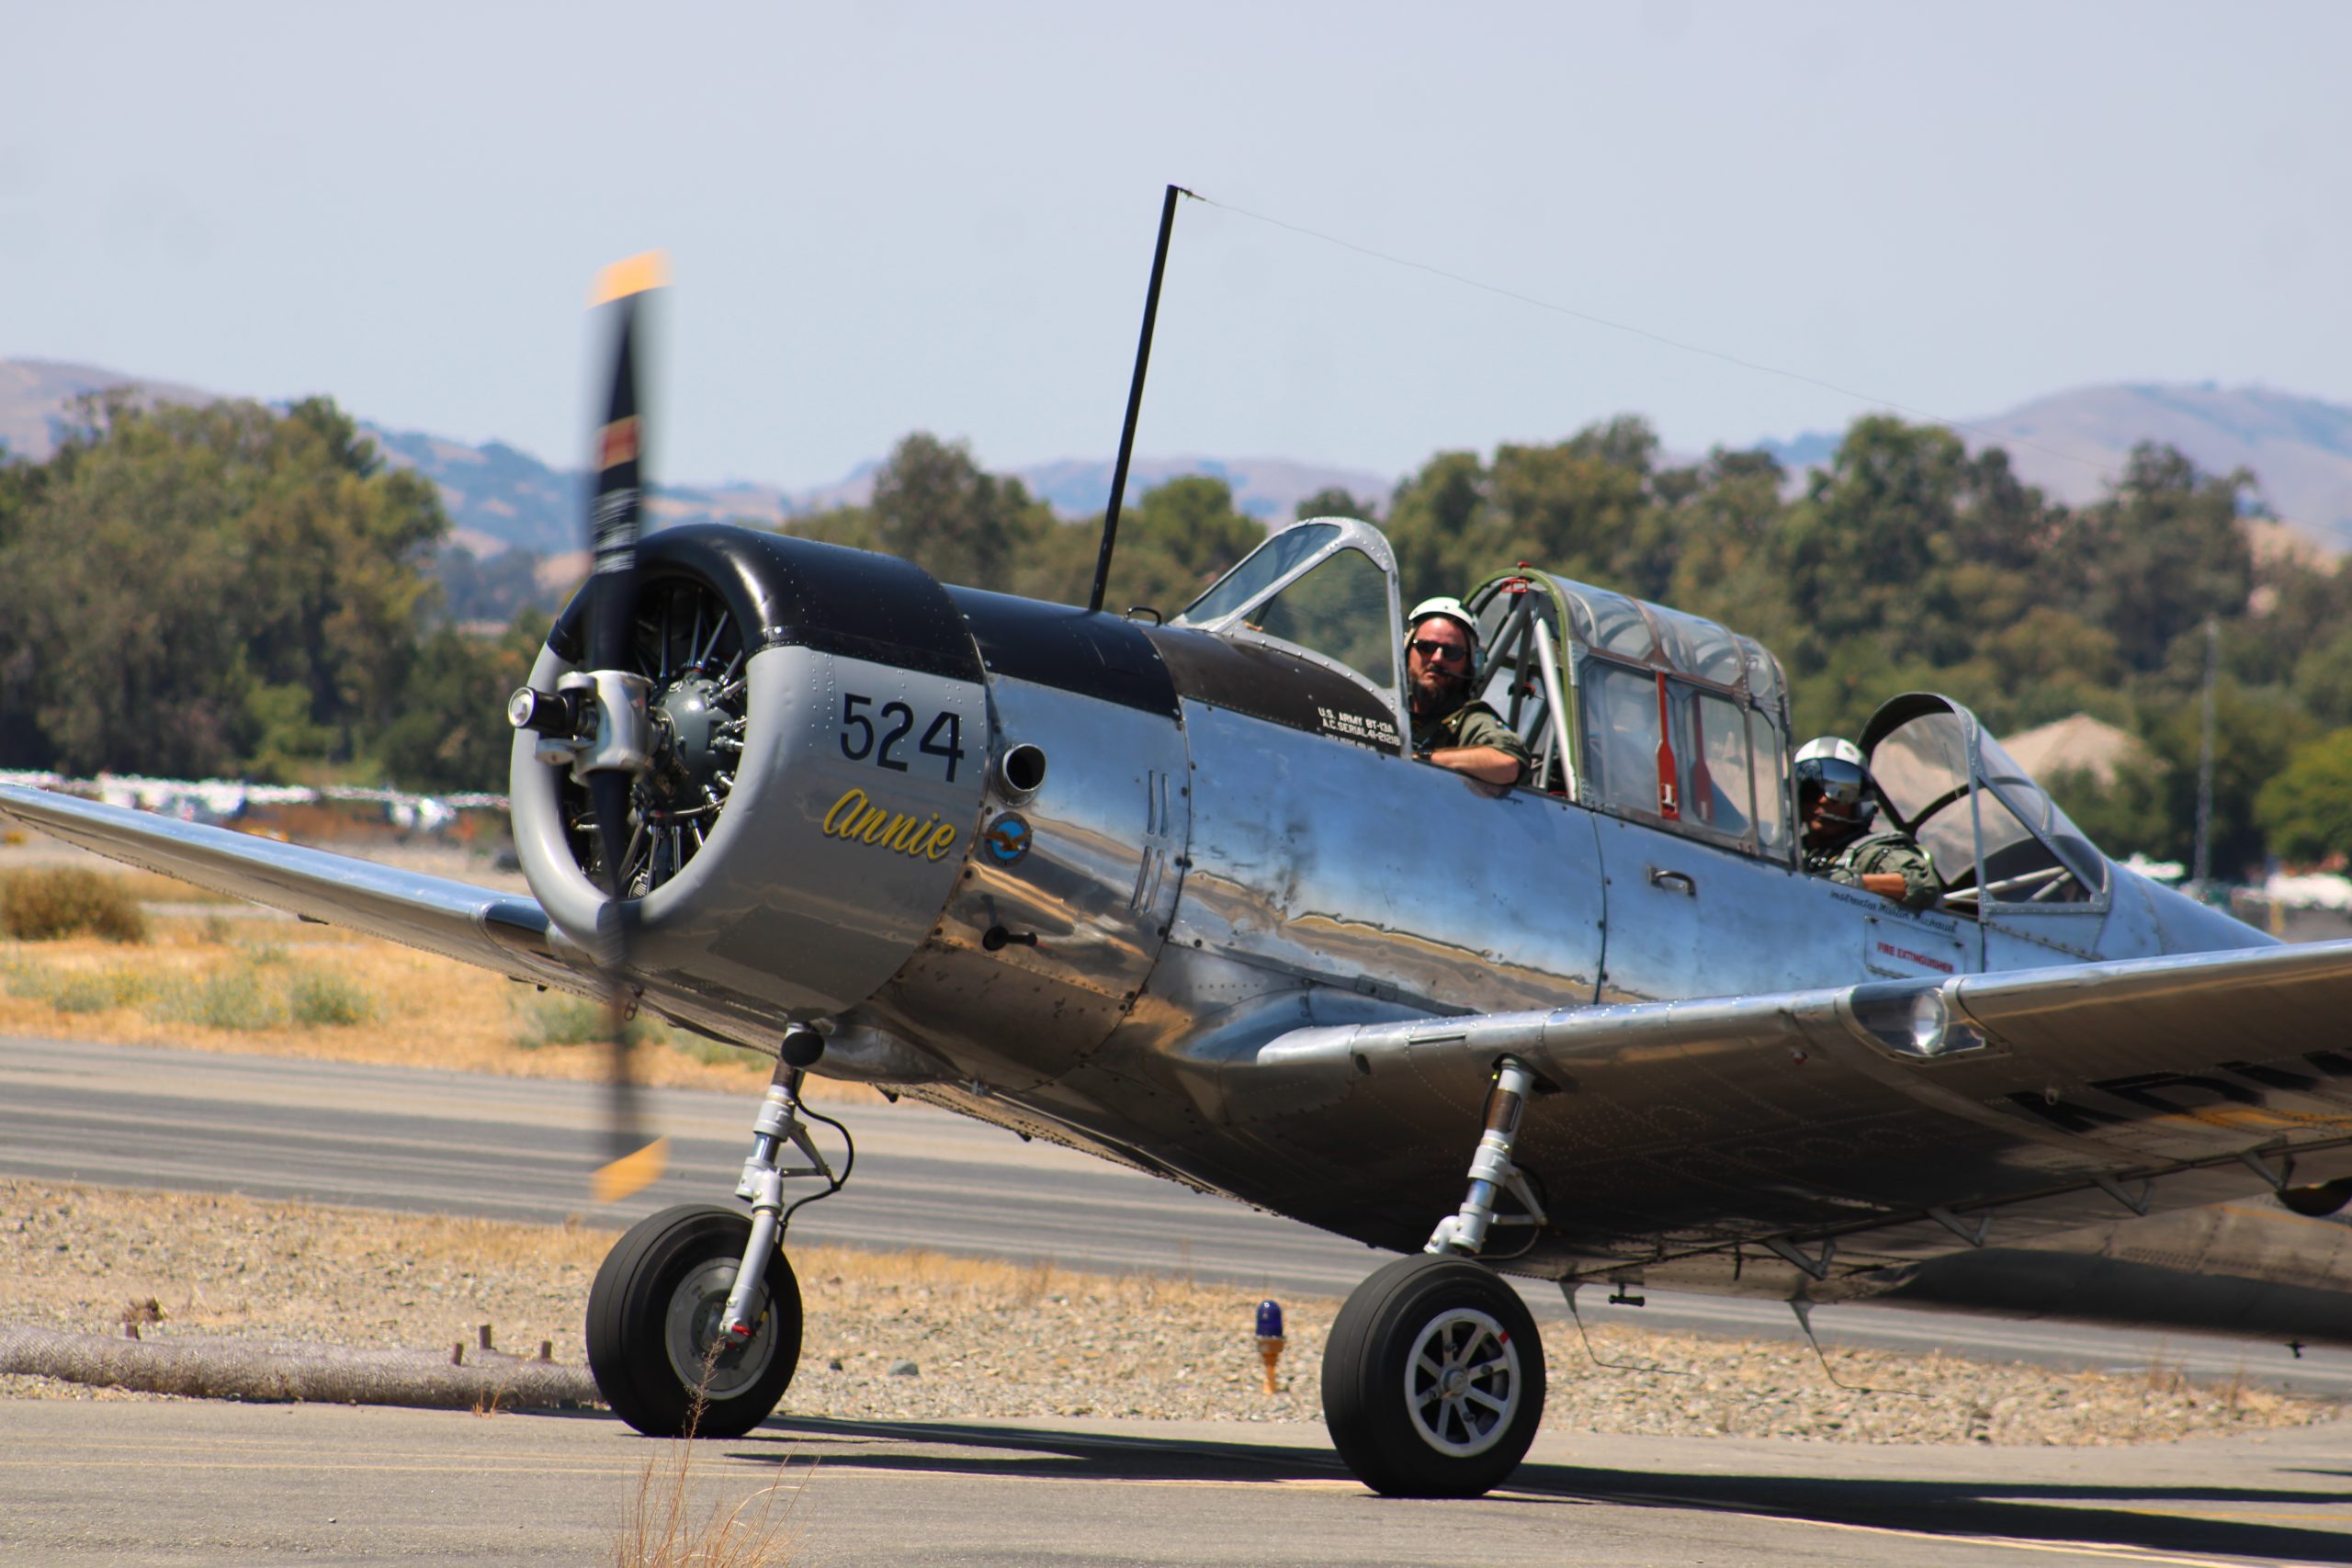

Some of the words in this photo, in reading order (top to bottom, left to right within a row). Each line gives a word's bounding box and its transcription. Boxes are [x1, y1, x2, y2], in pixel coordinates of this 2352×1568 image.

[840, 693, 964, 783] 524
[1339, 712, 1363, 726] ARMY
[1365, 718, 1394, 734] BT-13A
[1877, 941, 1895, 957] FIRE
[1896, 948, 1954, 975] EXTINGUISHER
